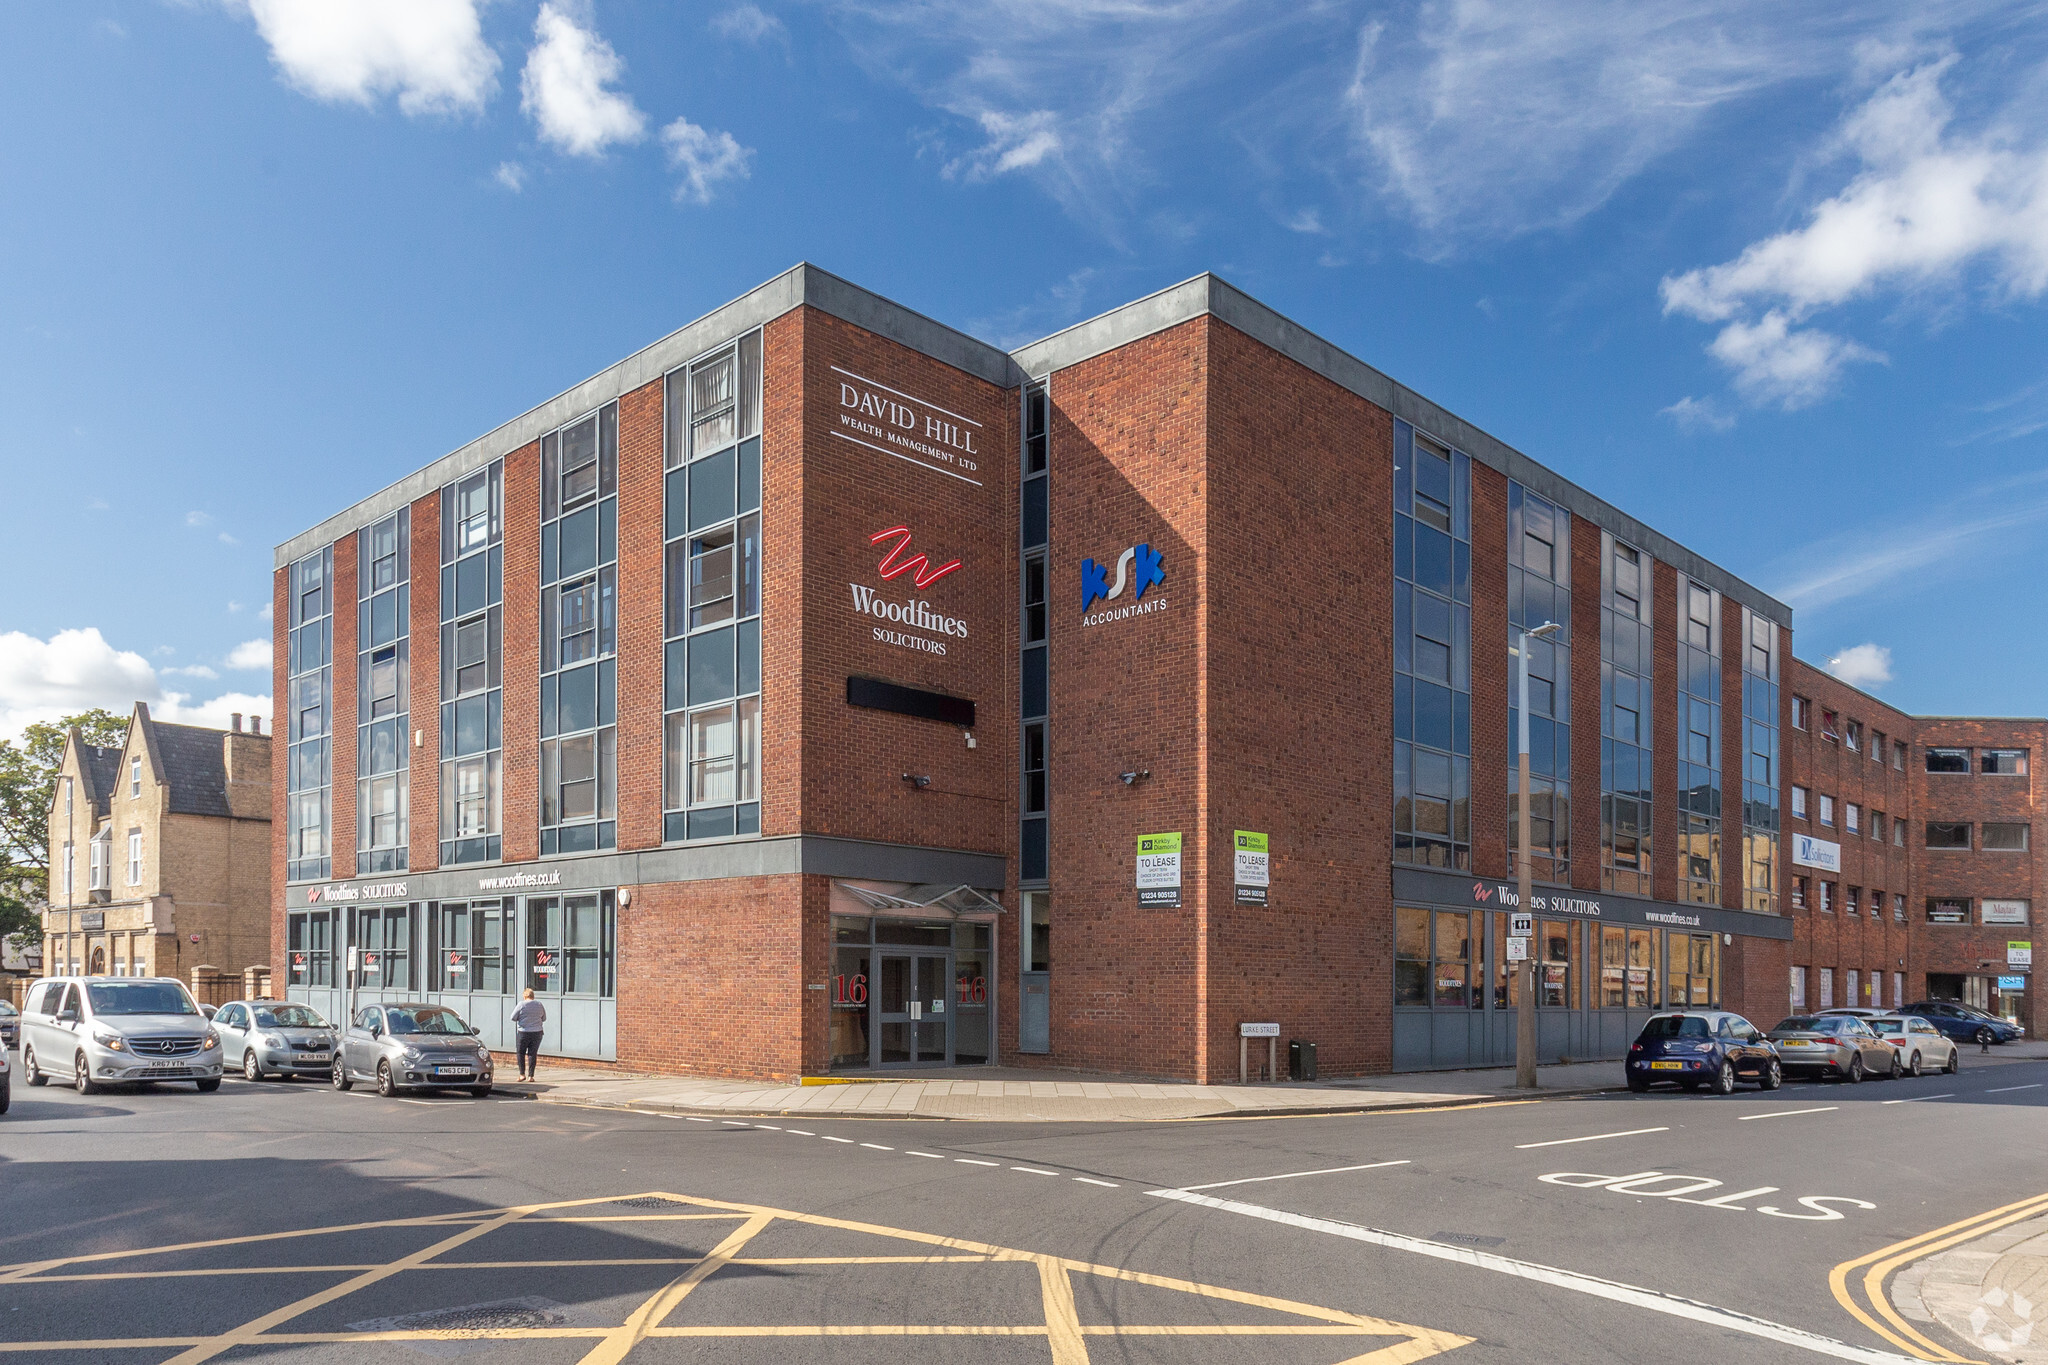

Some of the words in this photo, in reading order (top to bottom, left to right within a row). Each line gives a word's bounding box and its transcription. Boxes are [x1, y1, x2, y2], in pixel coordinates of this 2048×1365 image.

[840, 383, 915, 430] DAVID
[925, 416, 978, 454] HILL
[840, 414, 882, 438] WEALTH
[887, 433, 955, 463] MANAGEMENT
[959, 456, 978, 471] LTD
[849, 582, 969, 639] Woodfines
[1083, 598, 1168, 627] ACCOUNTANTS
[872, 626, 947, 656] SOLICITORS
[1248, 836, 1260, 844] Kirkby
[1248, 842, 1266, 850] Diamond
[1141, 858, 1150, 868] TO
[1152, 856, 1176, 867] LEASE
[1238, 854, 1247, 864] TO
[1248, 855, 1266, 866] LEASE
[323, 883, 359, 902] Woodfines
[362, 882, 408, 899] SOLICITORS
[479, 869, 560, 890] www.woodfines.co.uk
[1551, 896, 1600, 915] SOLICITORS
[833, 974, 867, 1003] 16
[957, 976, 986, 1003] 16
[1537, 1171, 1877, 1221] STOP
